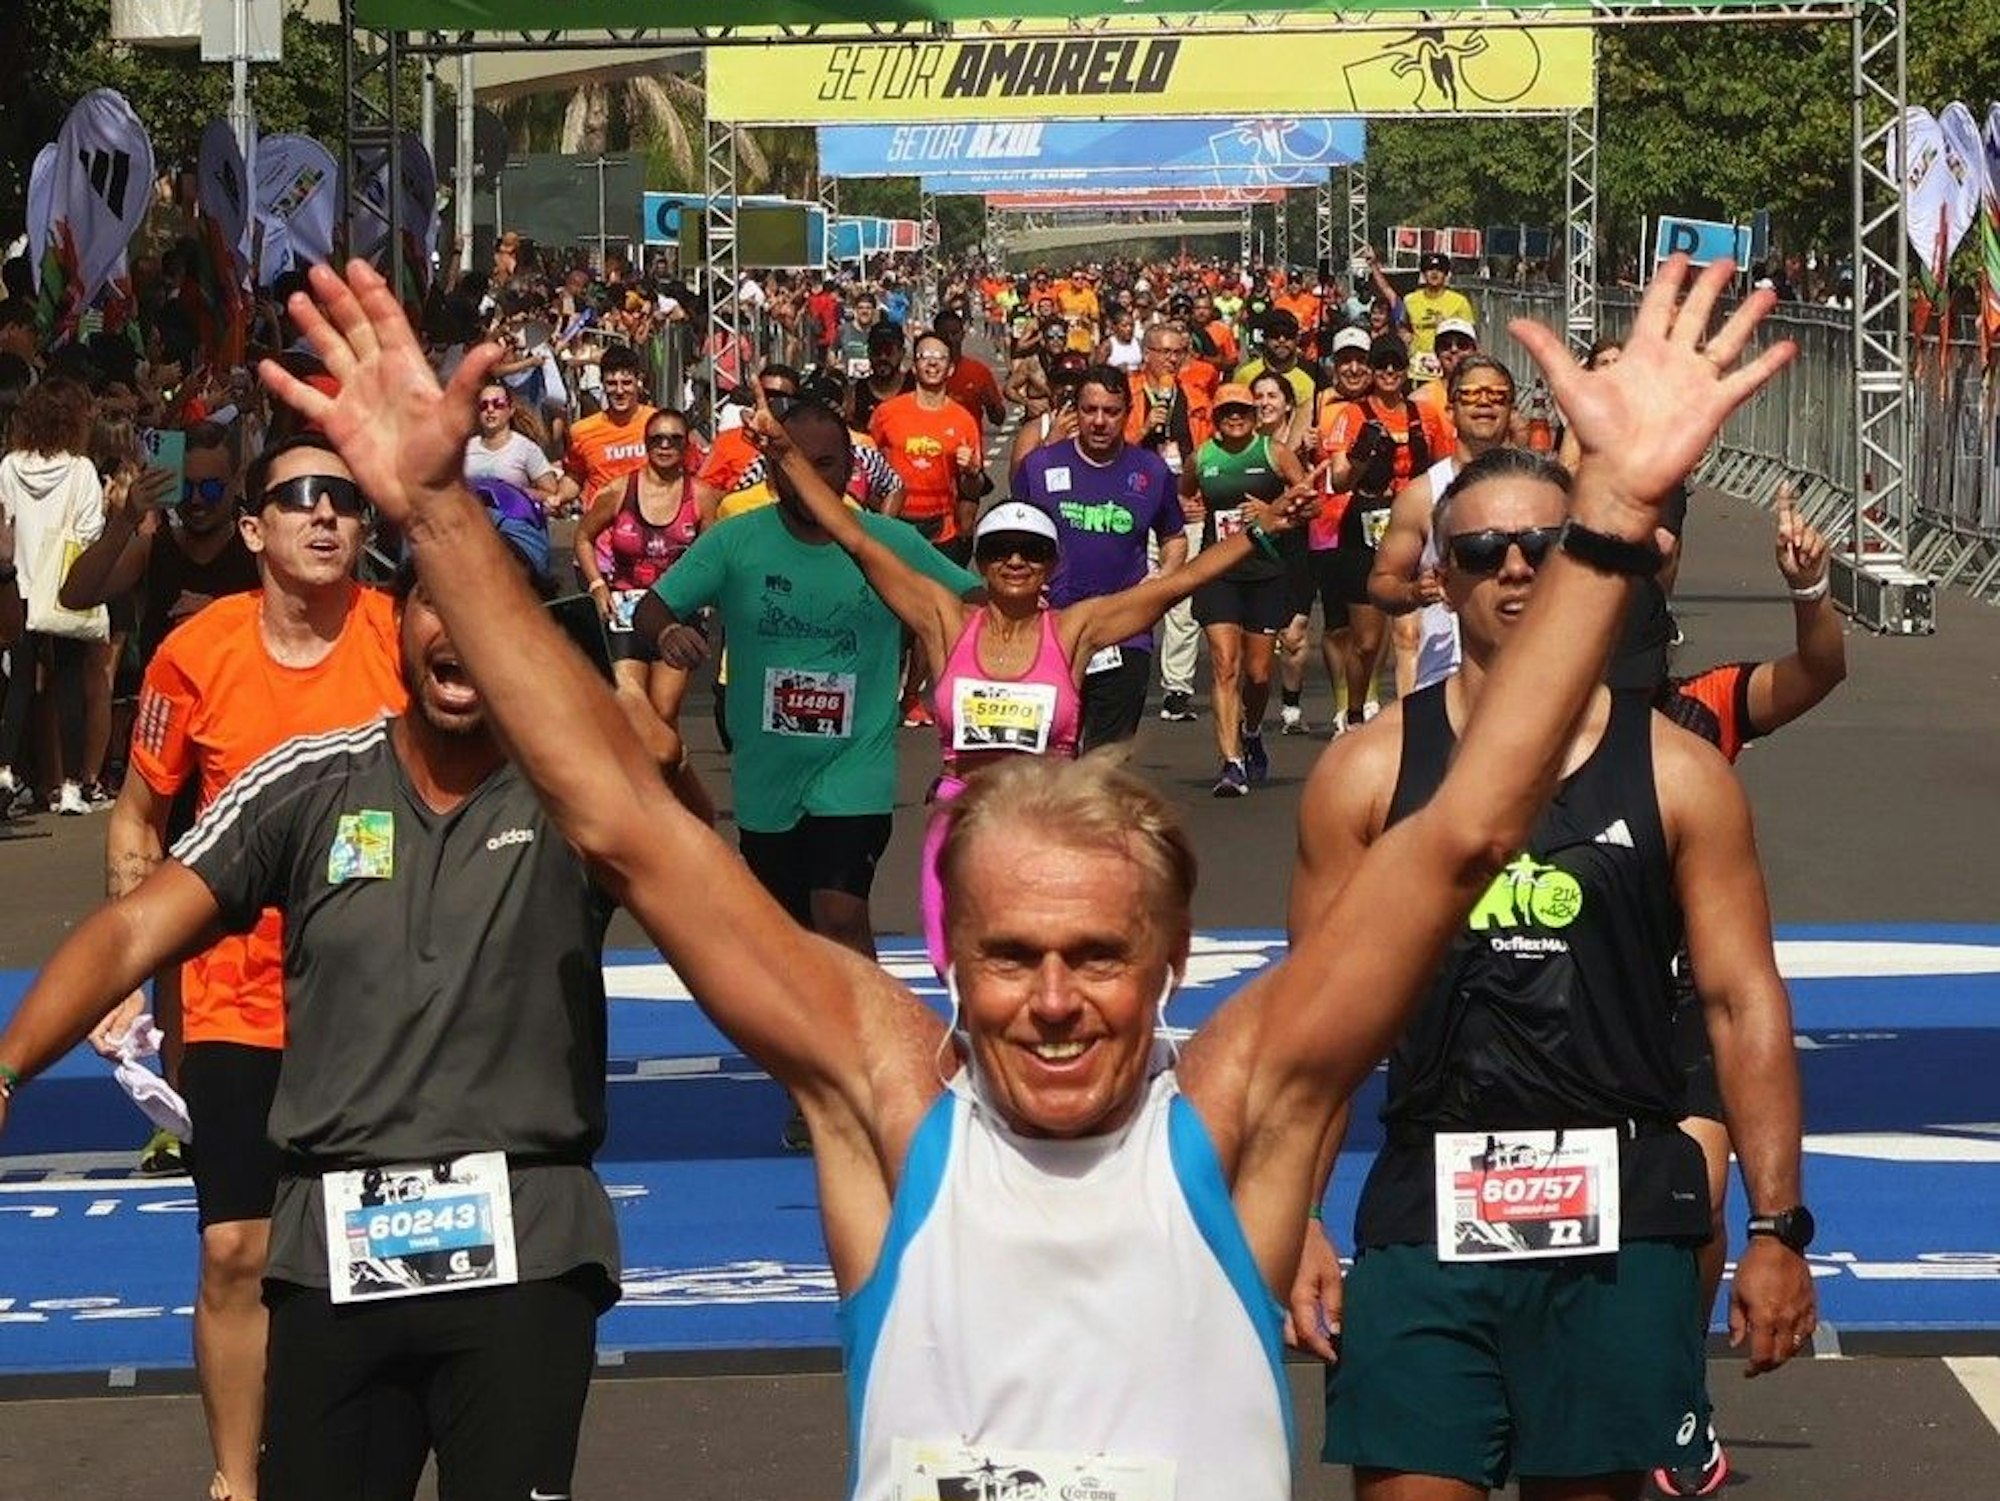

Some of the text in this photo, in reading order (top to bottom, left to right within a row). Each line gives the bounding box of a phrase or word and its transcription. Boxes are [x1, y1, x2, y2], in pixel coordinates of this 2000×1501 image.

[818, 39, 1181, 101] SETOR AMARELO
[887, 122, 1046, 163] SETOR AZUL
[1668, 224, 1699, 256] D
[1483, 1174, 1584, 1204] 60757
[369, 1203, 477, 1240] 60243
